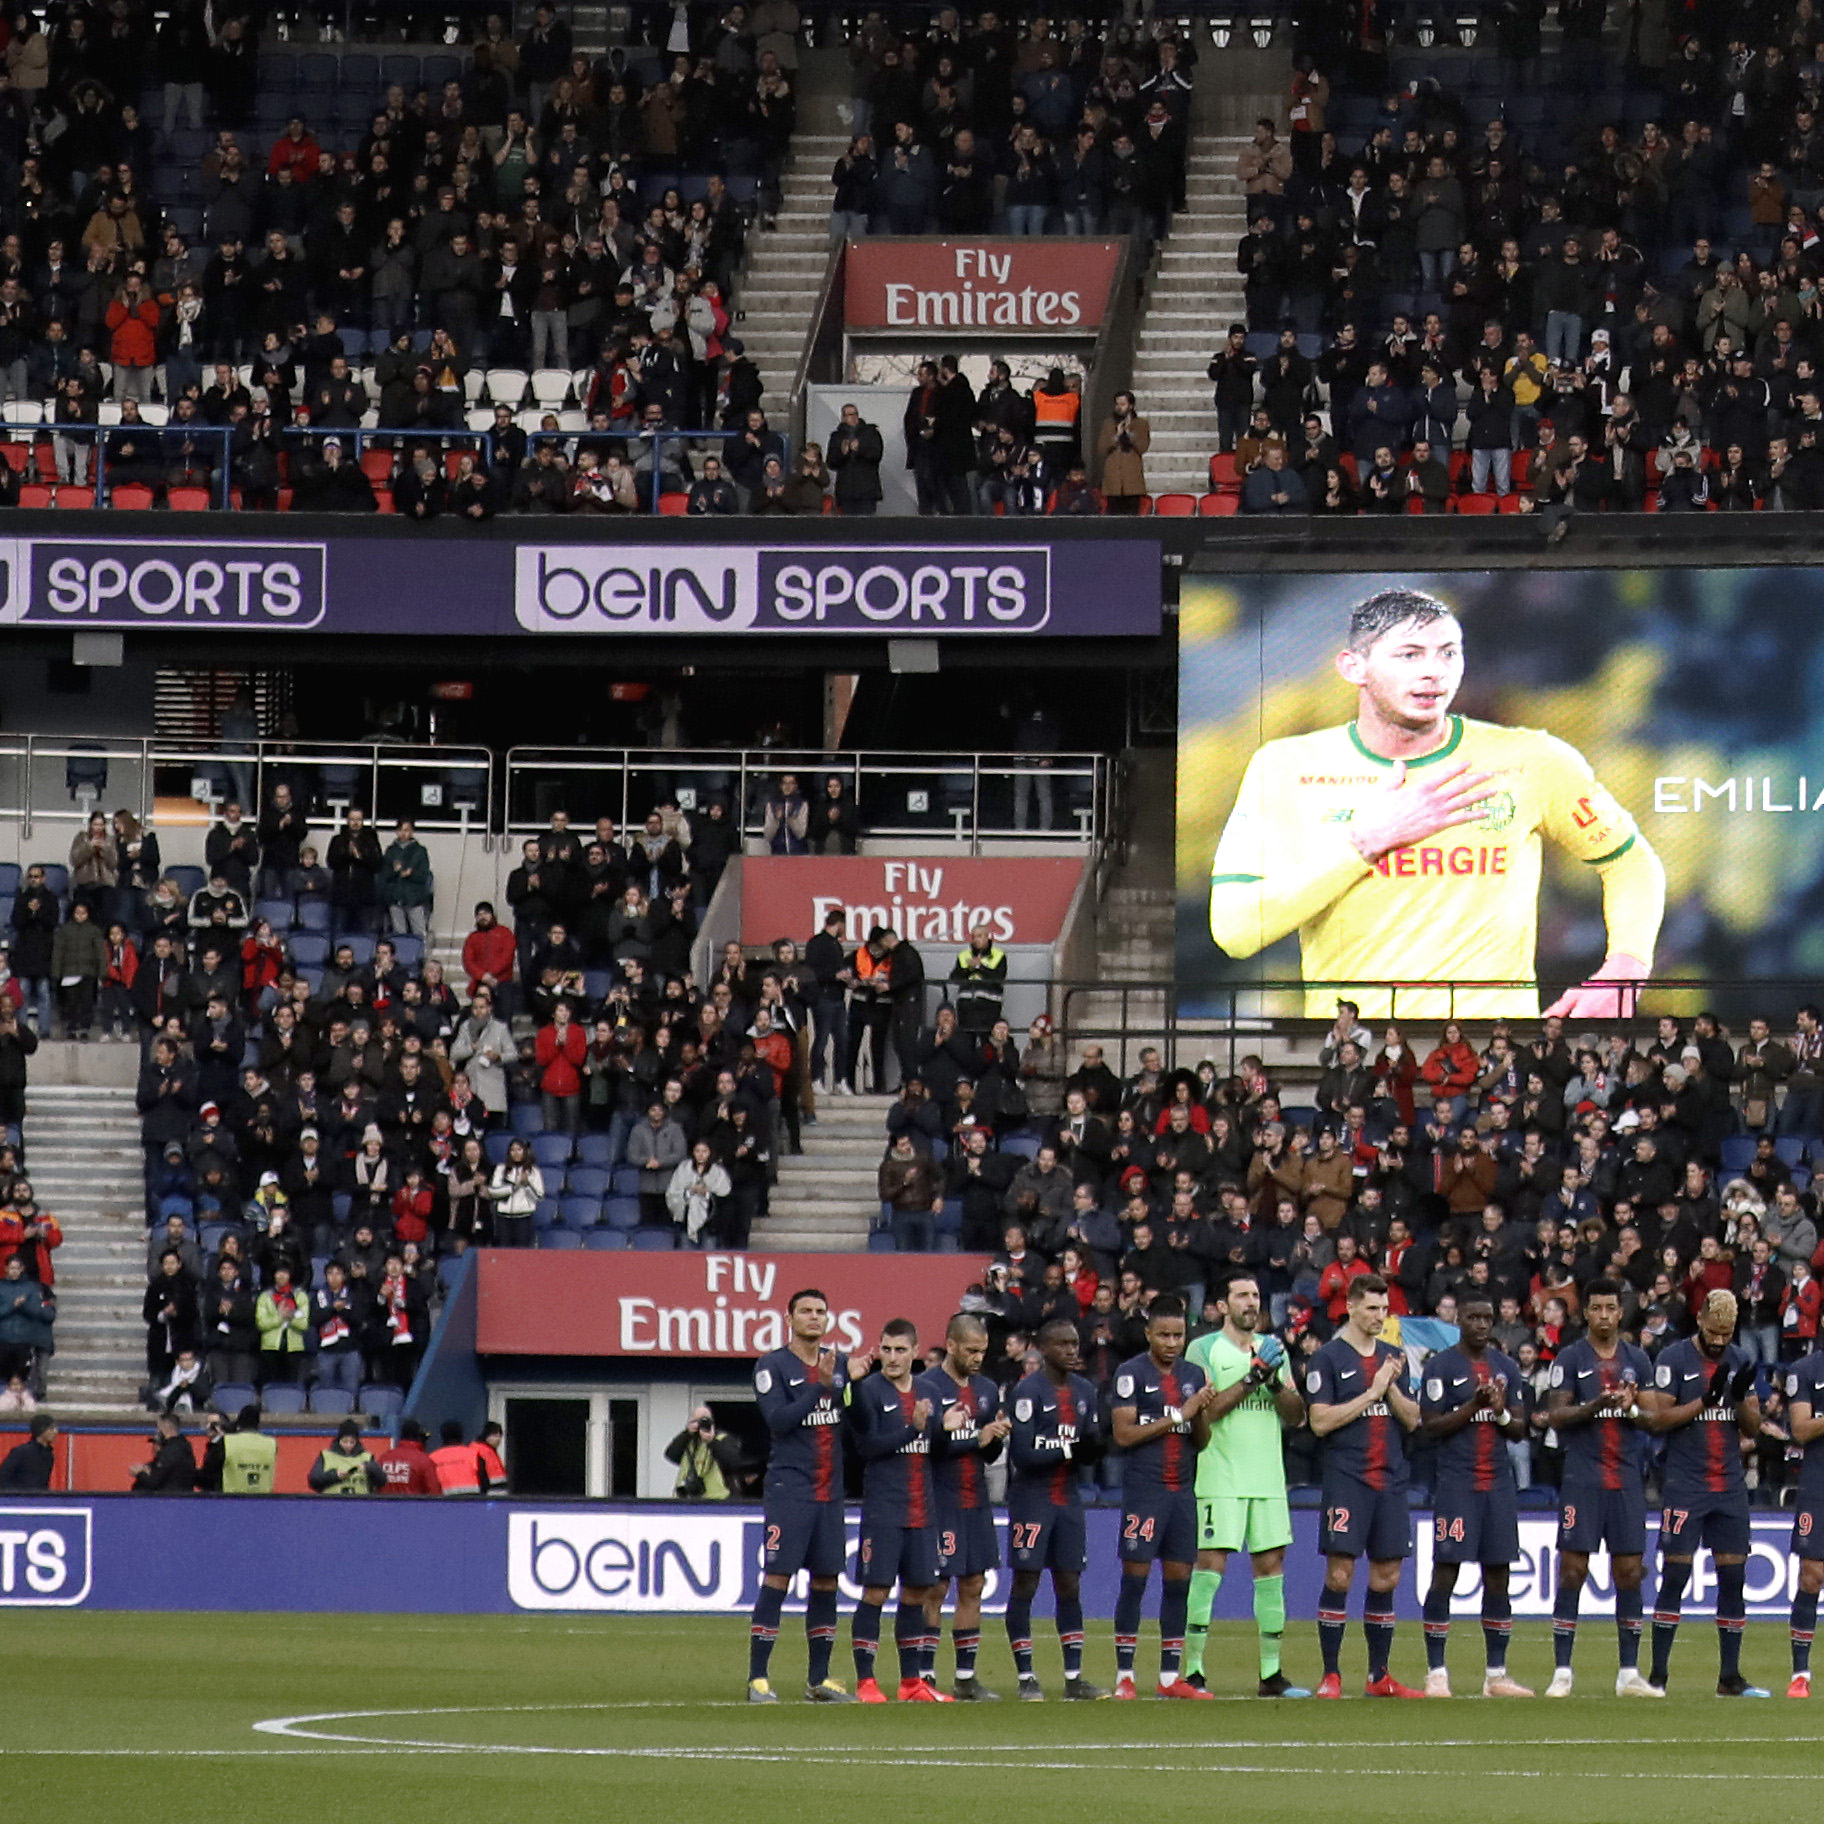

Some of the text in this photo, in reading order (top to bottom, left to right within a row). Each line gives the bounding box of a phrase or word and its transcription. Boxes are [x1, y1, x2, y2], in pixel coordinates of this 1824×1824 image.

[955, 249, 1012, 284] Fly
[885, 281, 1081, 326] Emirates
[47, 557, 303, 617] SPORTS
[539, 552, 1027, 624] beIN SPORTS
[1371, 847, 1507, 878] NERGIE
[883, 860, 943, 900] Fly
[812, 895, 1015, 943] Emirates
[705, 1254, 777, 1301] Fly
[617, 1295, 864, 1353] Emiraes
[1123, 1514, 1156, 1543] 24
[1203, 1503, 1214, 1526] 1
[1326, 1507, 1350, 1533] 12
[1435, 1516, 1465, 1543] 34
[1563, 1505, 1577, 1529] 3
[1661, 1508, 1689, 1535] 17
[1798, 1512, 1814, 1536] 9
[766, 1525, 782, 1551] 2
[1012, 1523, 1042, 1549] 27
[531, 1520, 721, 1596] beIN
